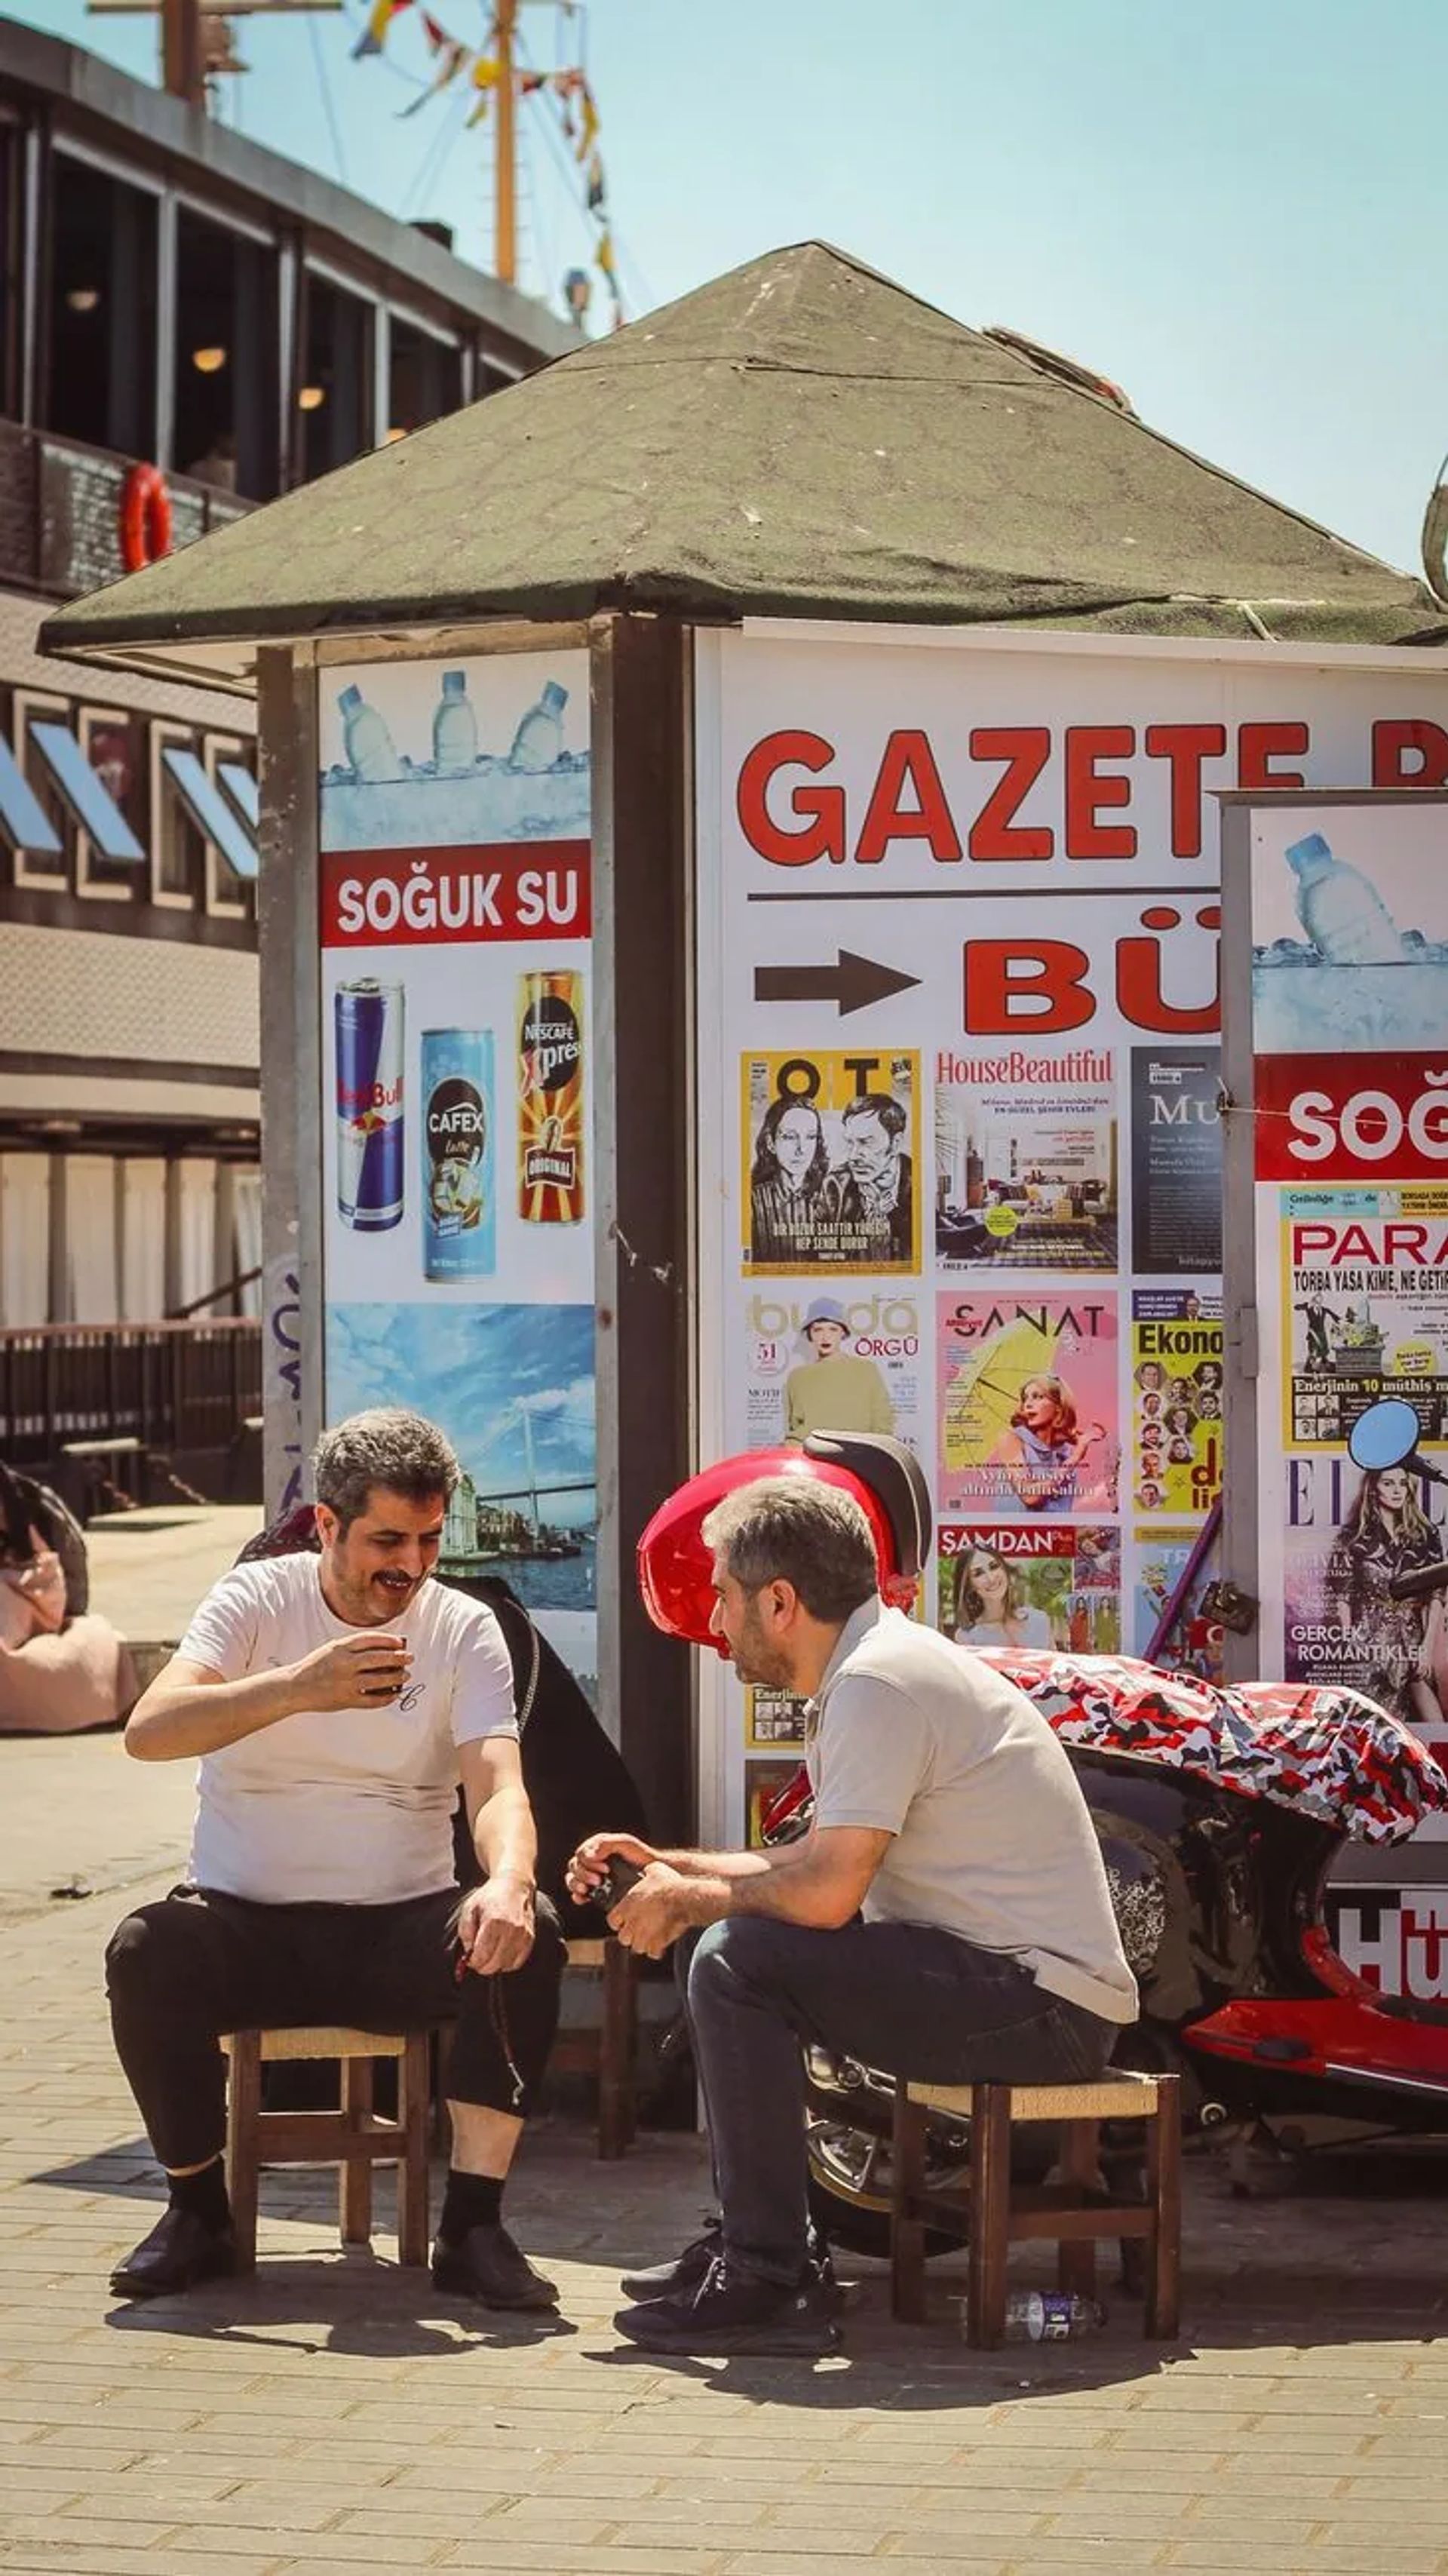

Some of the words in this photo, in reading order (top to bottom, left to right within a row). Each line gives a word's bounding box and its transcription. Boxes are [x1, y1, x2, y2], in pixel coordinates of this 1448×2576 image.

[338, 860, 502, 932] SOĞUK
[516, 869, 578, 926] SU
[963, 905, 1222, 1036] BÜ
[429, 1113, 484, 1133] CAFEX
[1287, 1070, 1448, 1162] SOĞ
[1293, 1224, 1448, 1266] PAR
[1293, 1270, 1331, 1291] TORBA
[1333, 1270, 1364, 1291] YASA
[1400, 1270, 1416, 1291] NE
[750, 1293, 919, 1339] bda
[953, 1304, 1105, 1337] SANAT
[855, 1334, 919, 1357] ÖRGÜ
[1138, 1323, 1223, 1355] Ekono
[1294, 1379, 1358, 1395] Enerjinin
[1361, 1379, 1379, 1392] 10
[1382, 1379, 1431, 1393] müthiş
[942, 1531, 1052, 1555] ŞAMDAN
[1290, 1625, 1364, 1643] GERÇEK
